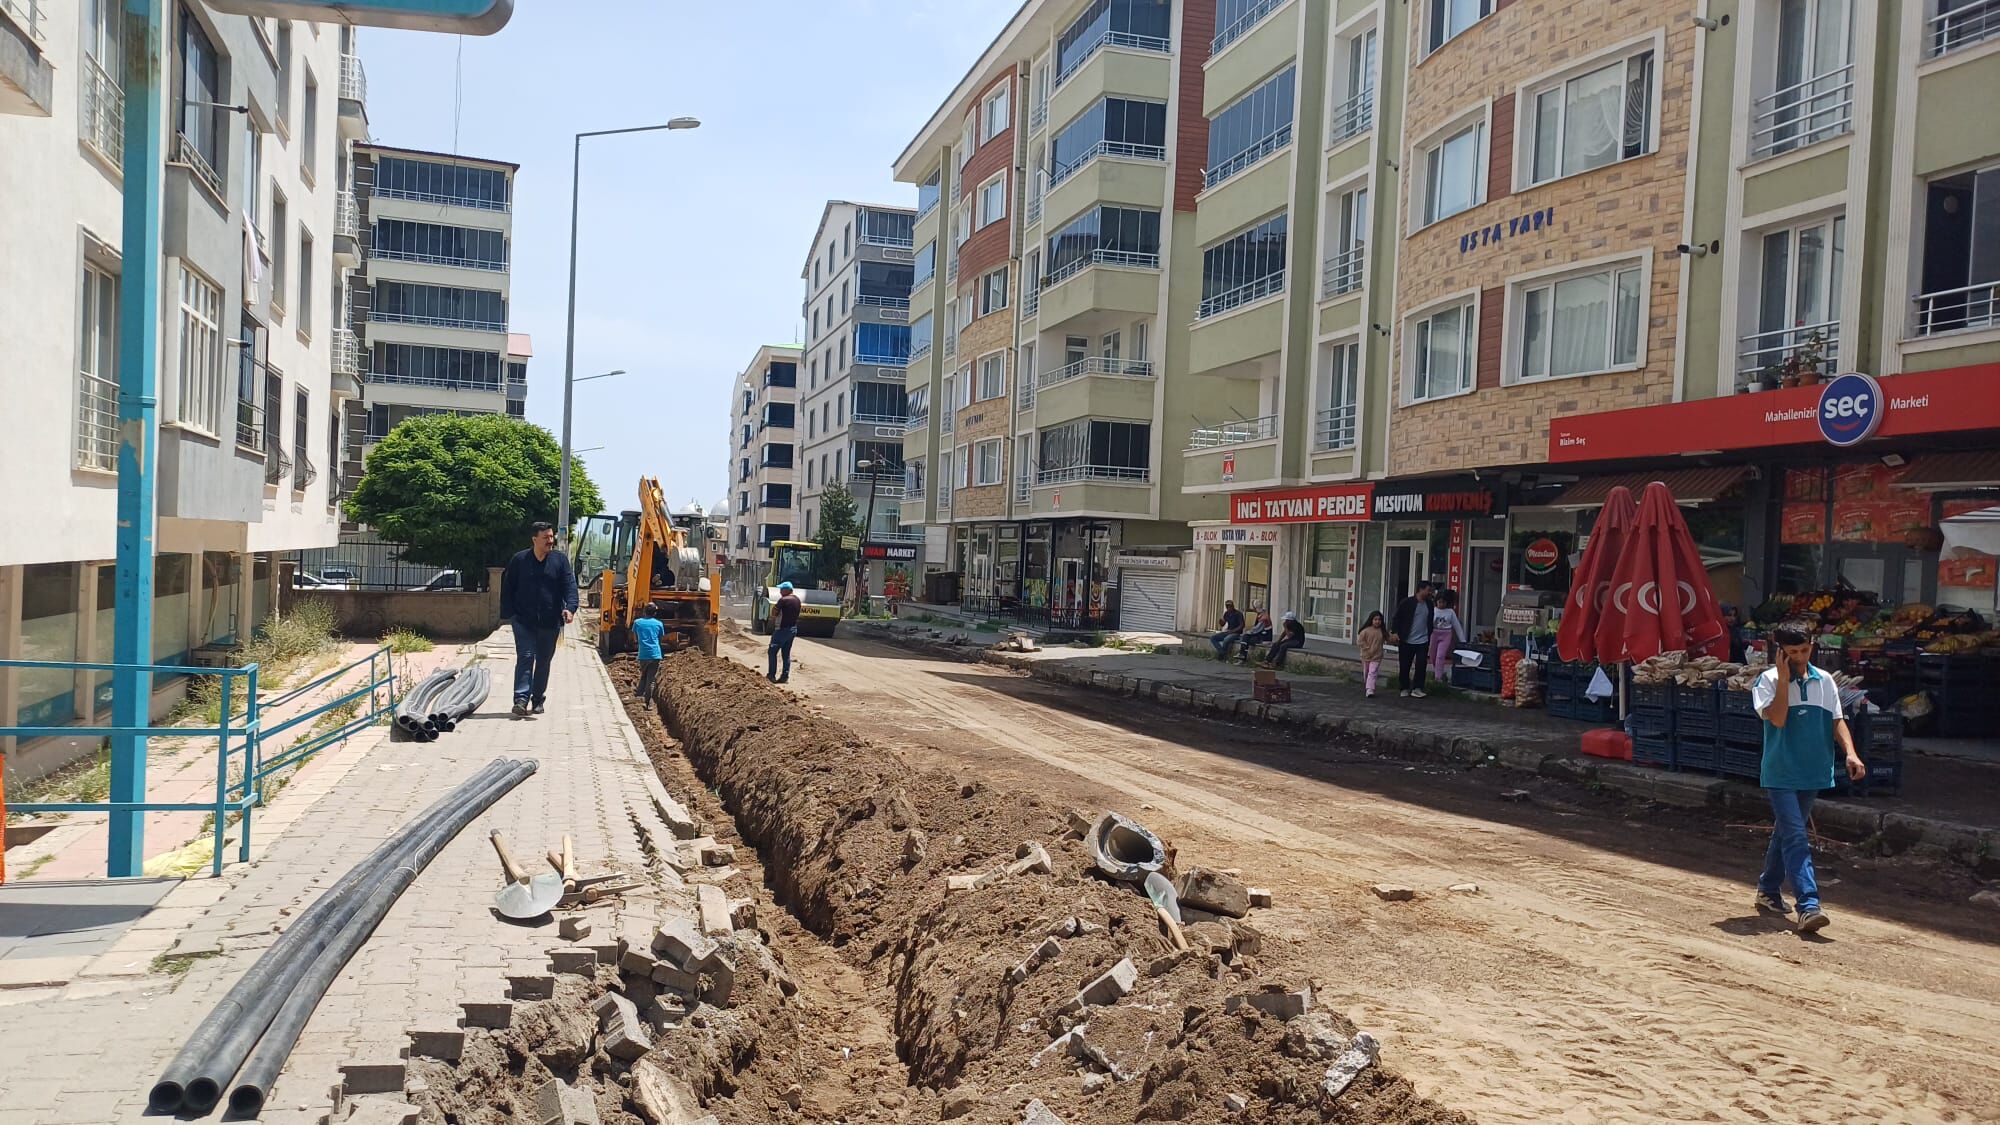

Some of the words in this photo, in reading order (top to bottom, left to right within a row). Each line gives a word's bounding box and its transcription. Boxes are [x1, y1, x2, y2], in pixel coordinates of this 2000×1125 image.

[1460, 223, 1501, 253] USTA
[1509, 207, 1554, 237] YAPI
[1824, 393, 1869, 419] seç
[1890, 394, 1929, 410] Marketi
[1264, 498, 1313, 518] TATVAN
[1317, 495, 1366, 516] PERDE
[1375, 494, 1423, 513] MESUTUM
[1221, 529, 1234, 541] USTA
[1261, 531, 1278, 541] BLOK
[886, 548, 916, 557] MARKET
